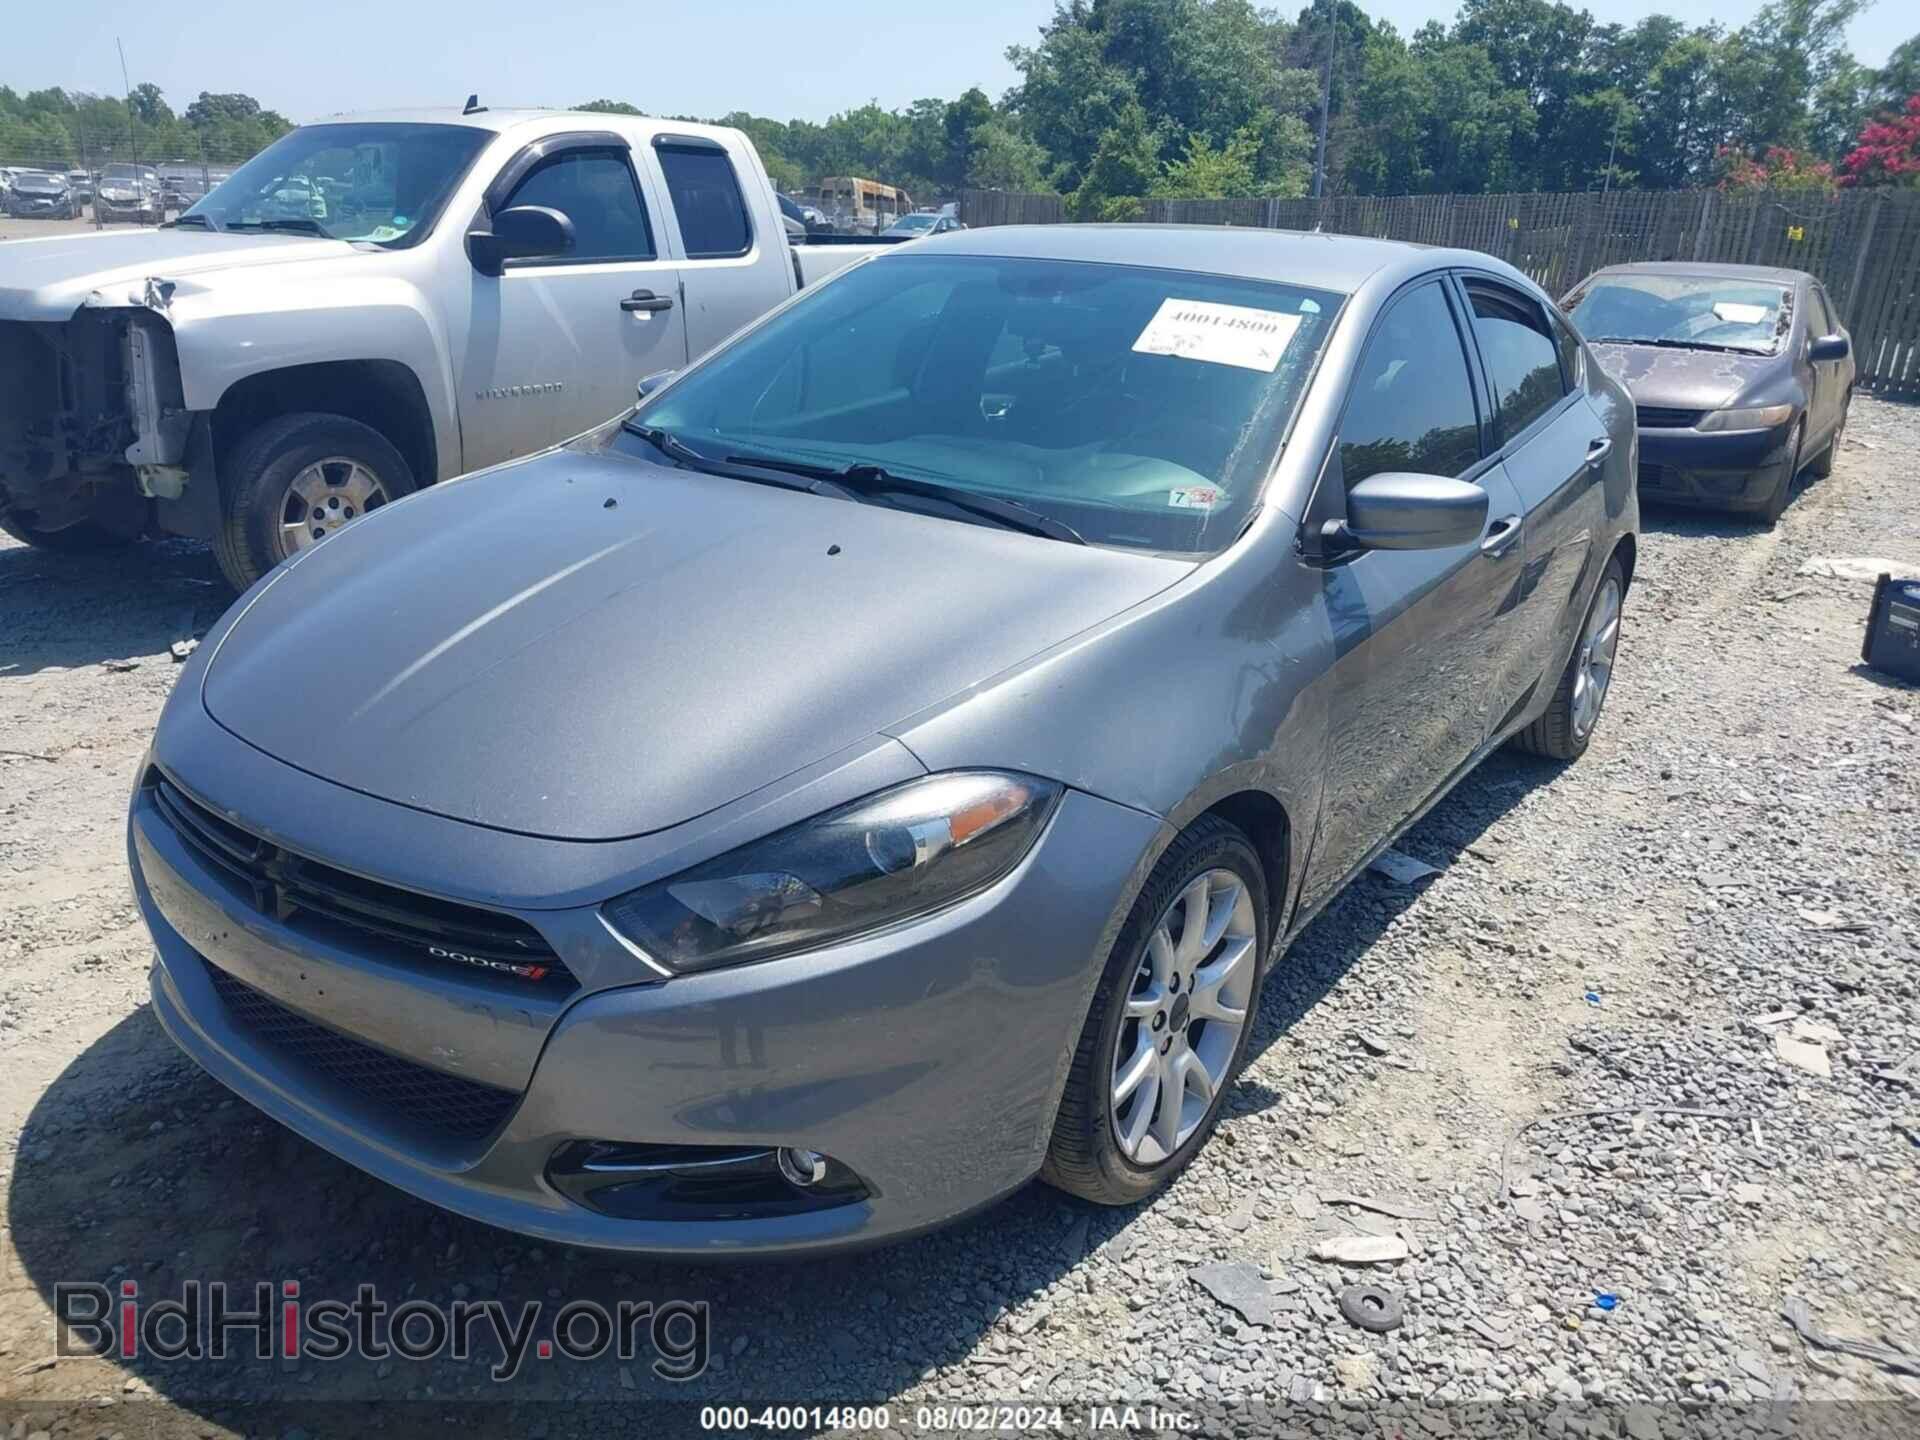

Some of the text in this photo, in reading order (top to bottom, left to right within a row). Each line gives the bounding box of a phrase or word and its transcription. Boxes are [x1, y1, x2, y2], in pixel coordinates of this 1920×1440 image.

[1170, 311, 1279, 334] 40014800
[474, 381, 563, 400] SILVERADO
[1175, 491, 1185, 503] 7
[429, 946, 531, 977] DODGE
